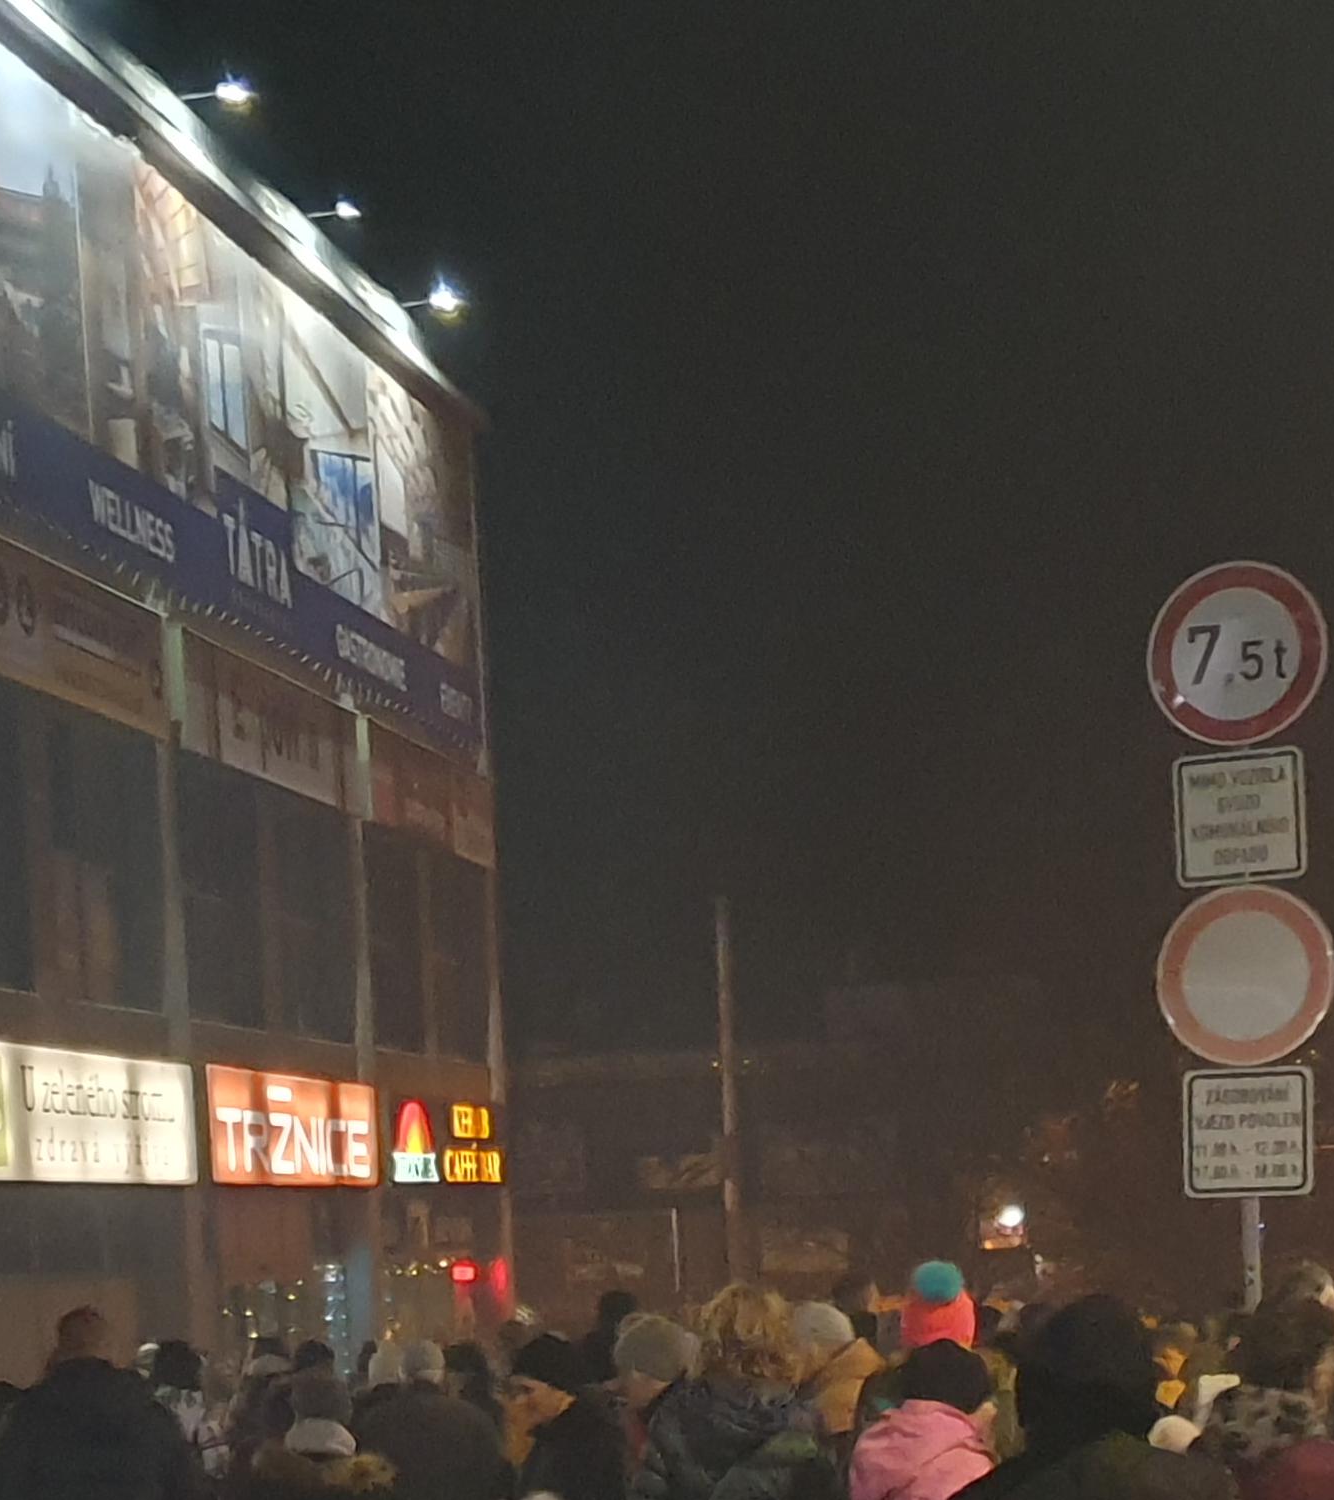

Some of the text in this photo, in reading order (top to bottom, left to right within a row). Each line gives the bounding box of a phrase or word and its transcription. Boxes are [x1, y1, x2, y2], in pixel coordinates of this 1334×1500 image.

[88, 479, 176, 564] WELLNESS
[20, 1065, 36, 1112] U
[42, 1068, 117, 1119] zeleného
[216, 1085, 371, 1179] TRŽNICE
